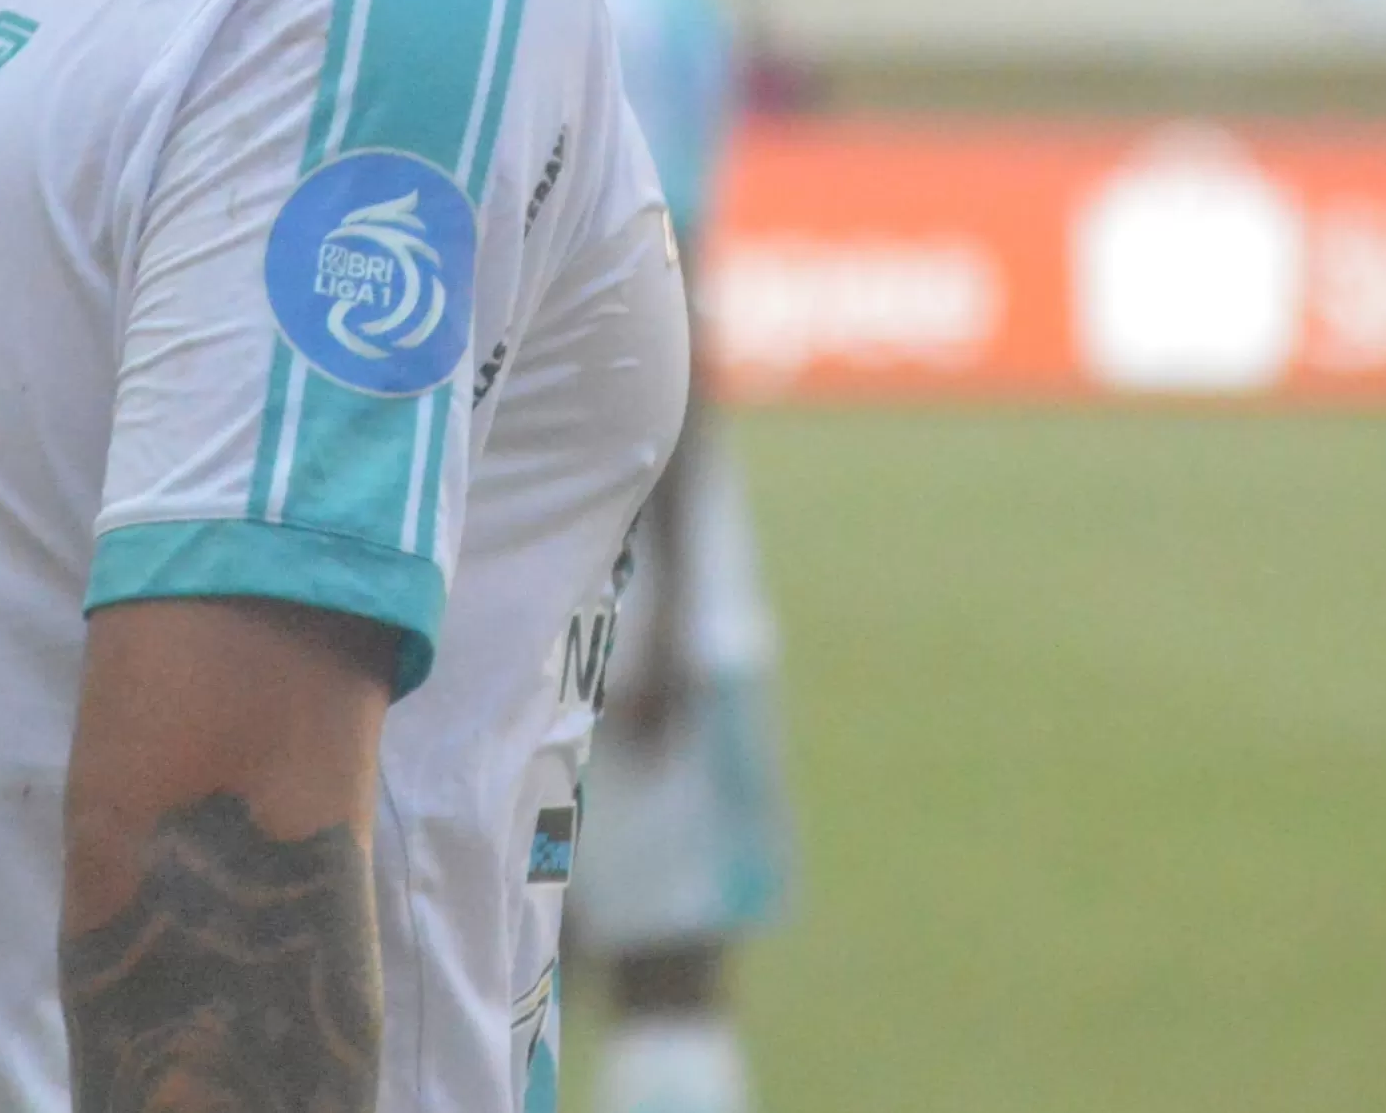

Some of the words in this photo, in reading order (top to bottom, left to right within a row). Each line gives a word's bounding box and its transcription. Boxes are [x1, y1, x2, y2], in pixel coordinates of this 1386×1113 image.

[347, 252, 395, 284] BRI
[314, 274, 375, 305] LIGA
[381, 286, 391, 308] 1
